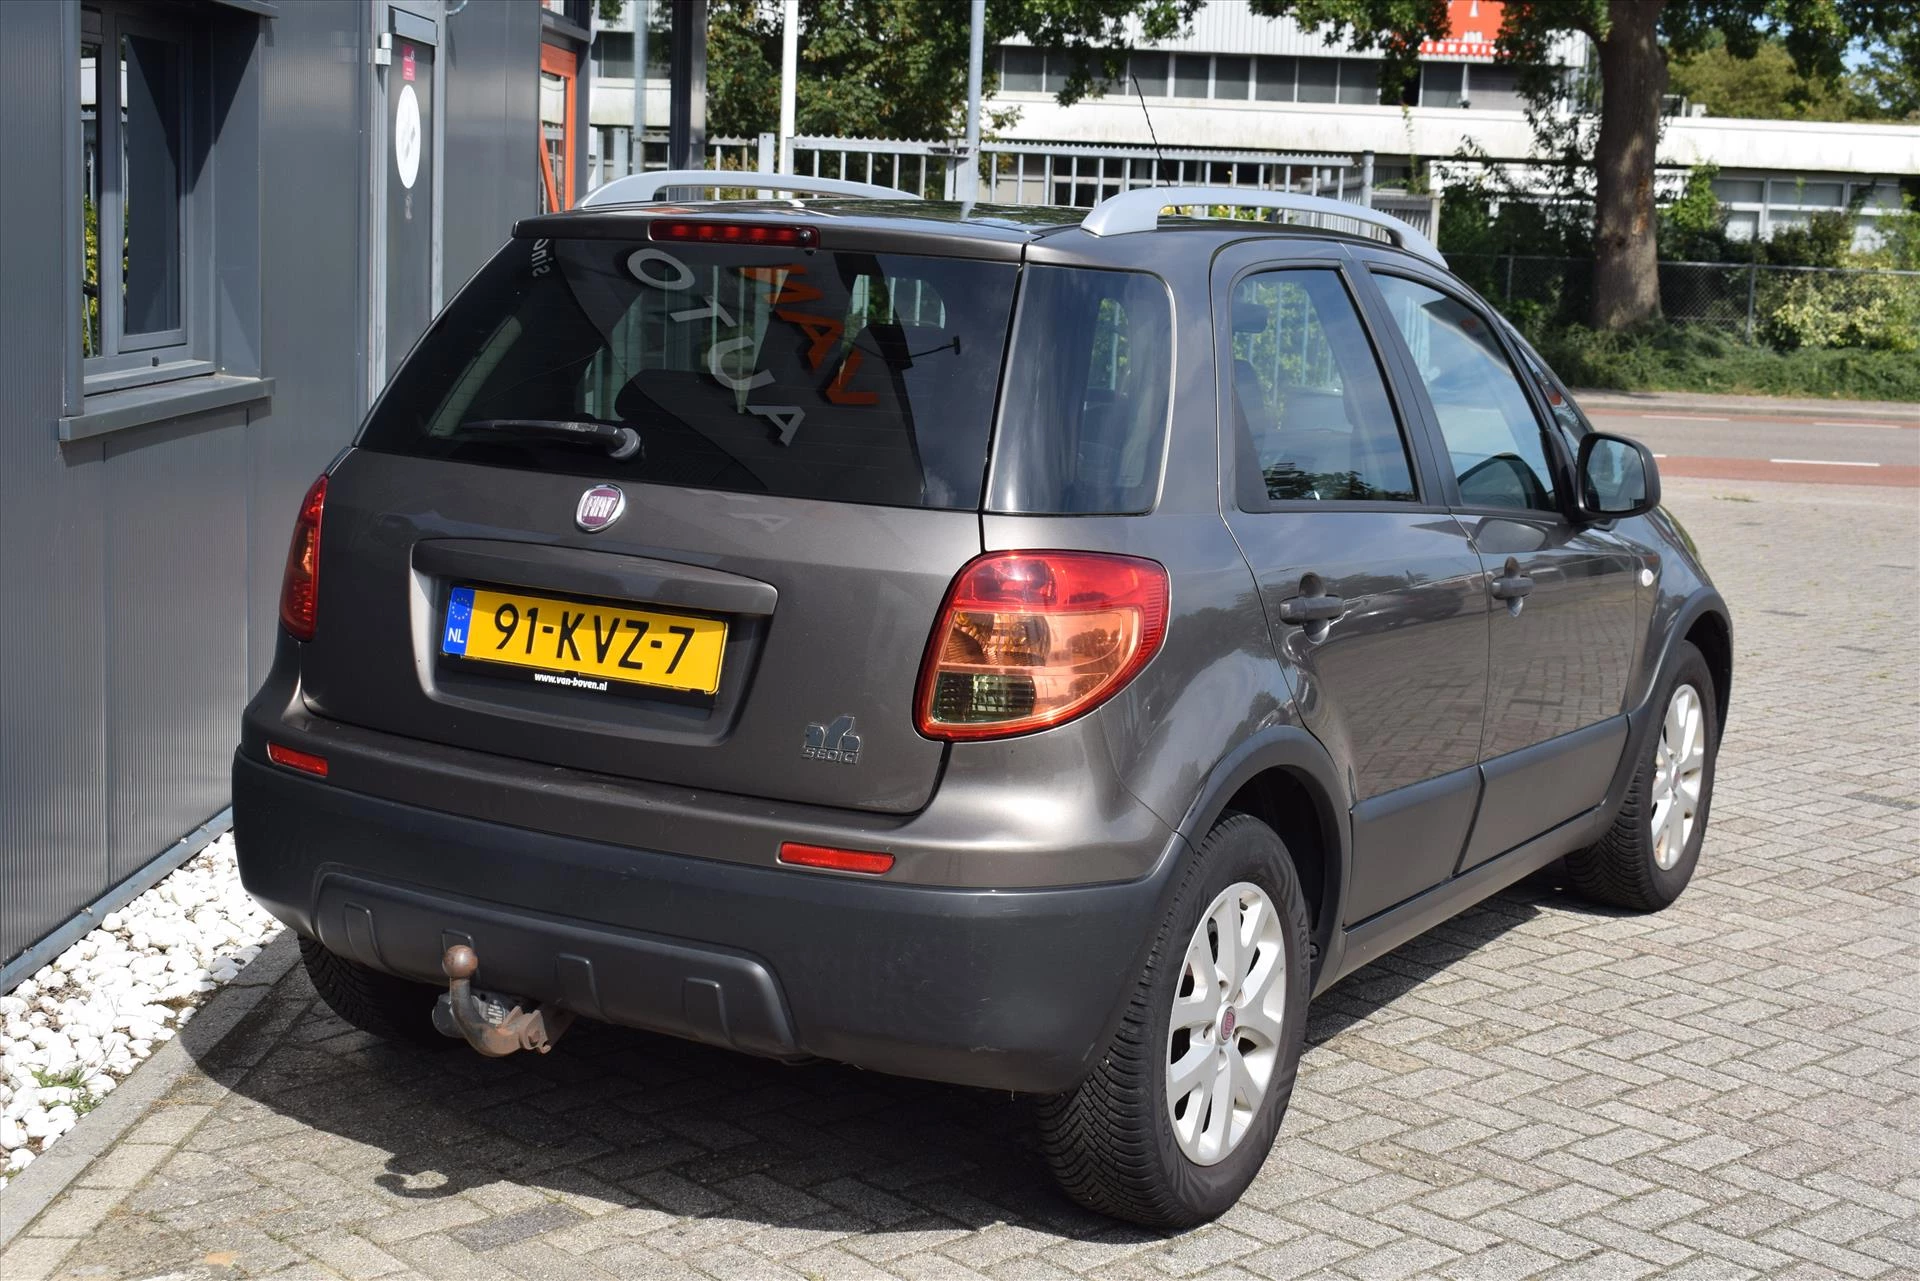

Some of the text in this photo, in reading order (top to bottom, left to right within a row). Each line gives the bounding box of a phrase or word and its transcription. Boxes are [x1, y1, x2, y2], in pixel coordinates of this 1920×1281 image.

[582, 495, 617, 518] FIAT
[447, 627, 465, 644] NL
[494, 603, 696, 674] 91-KVZ-7
[534, 673, 608, 691] www.van-boven.nl
